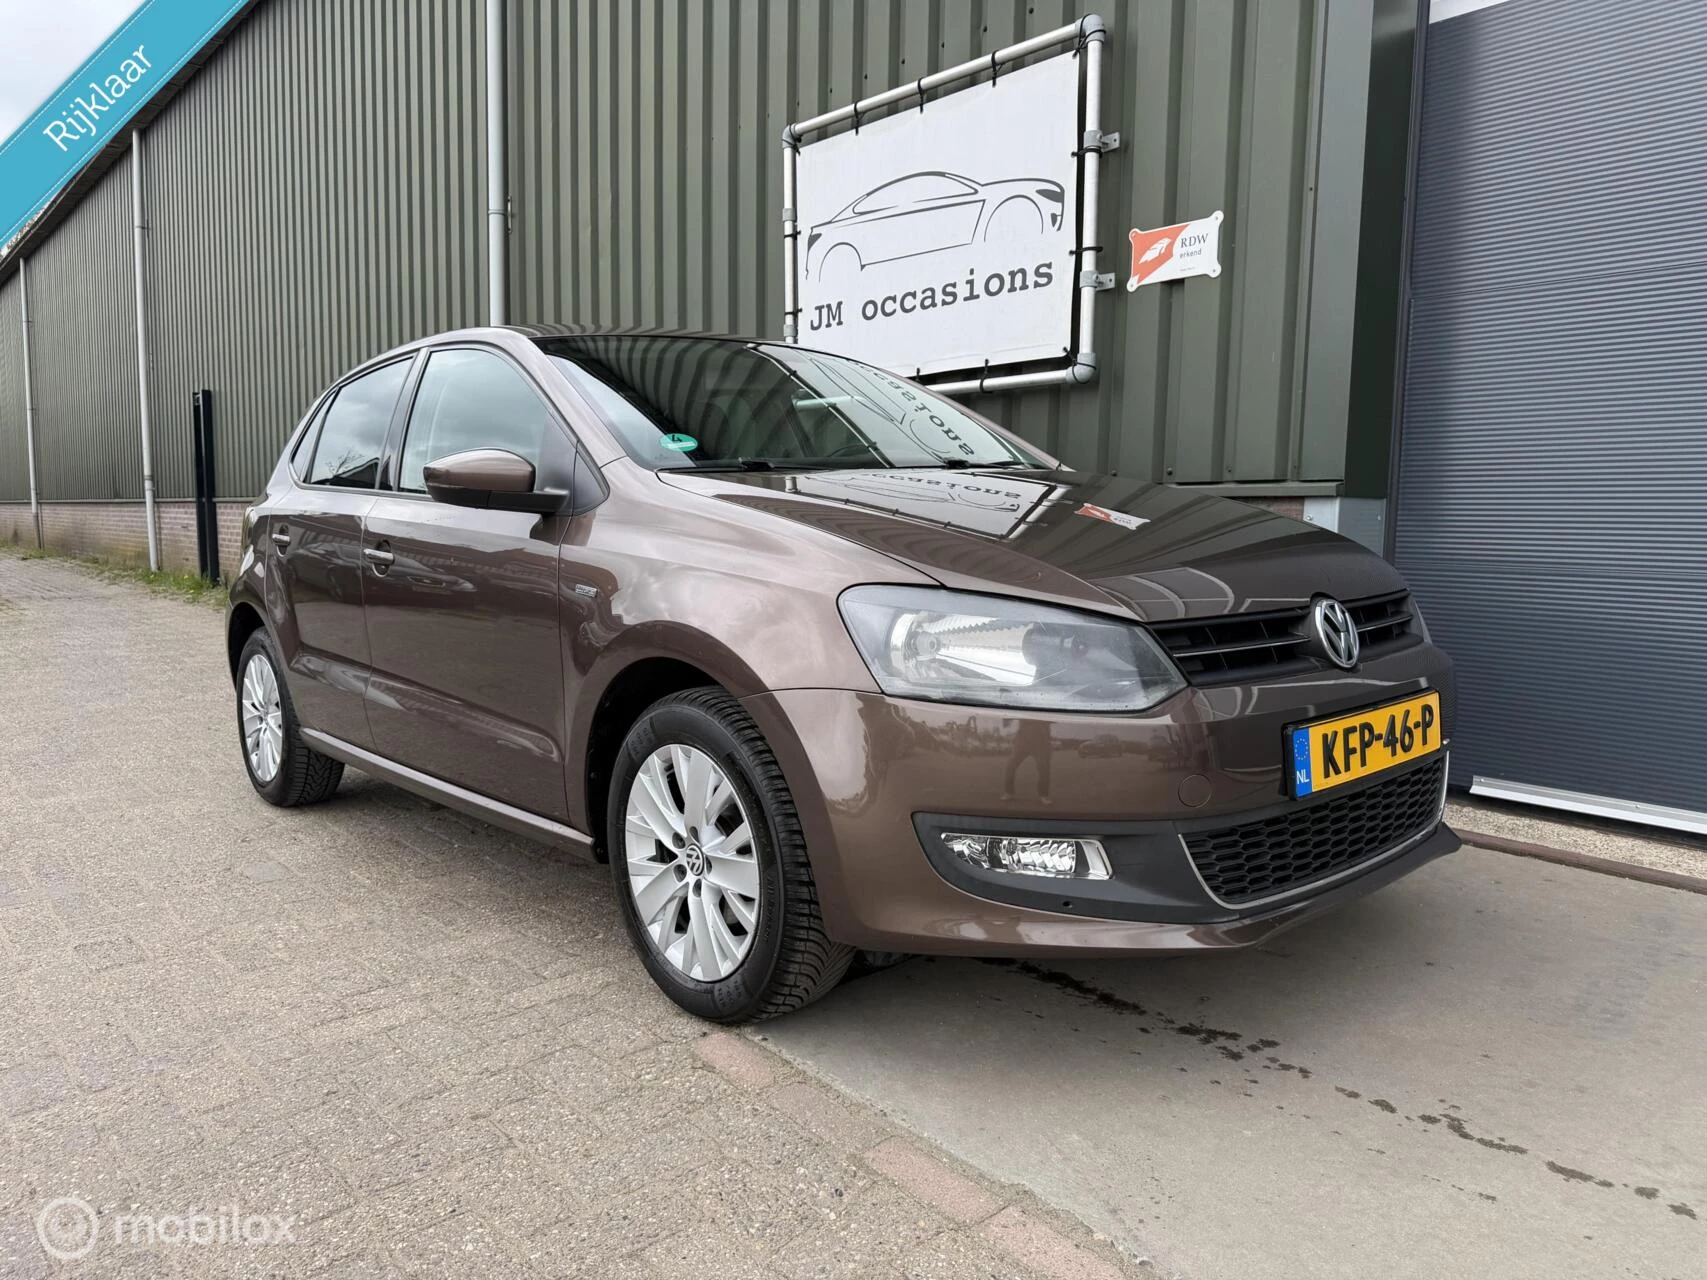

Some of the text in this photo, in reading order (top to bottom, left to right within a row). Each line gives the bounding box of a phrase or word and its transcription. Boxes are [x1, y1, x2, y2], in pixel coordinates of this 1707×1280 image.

[1180, 232, 1208, 249] RDW
[1179, 247, 1202, 259] erkend
[810, 261, 1054, 331] JM occasions
[1321, 703, 1435, 779] KFP-46-P
[1296, 770, 1310, 785] NL
